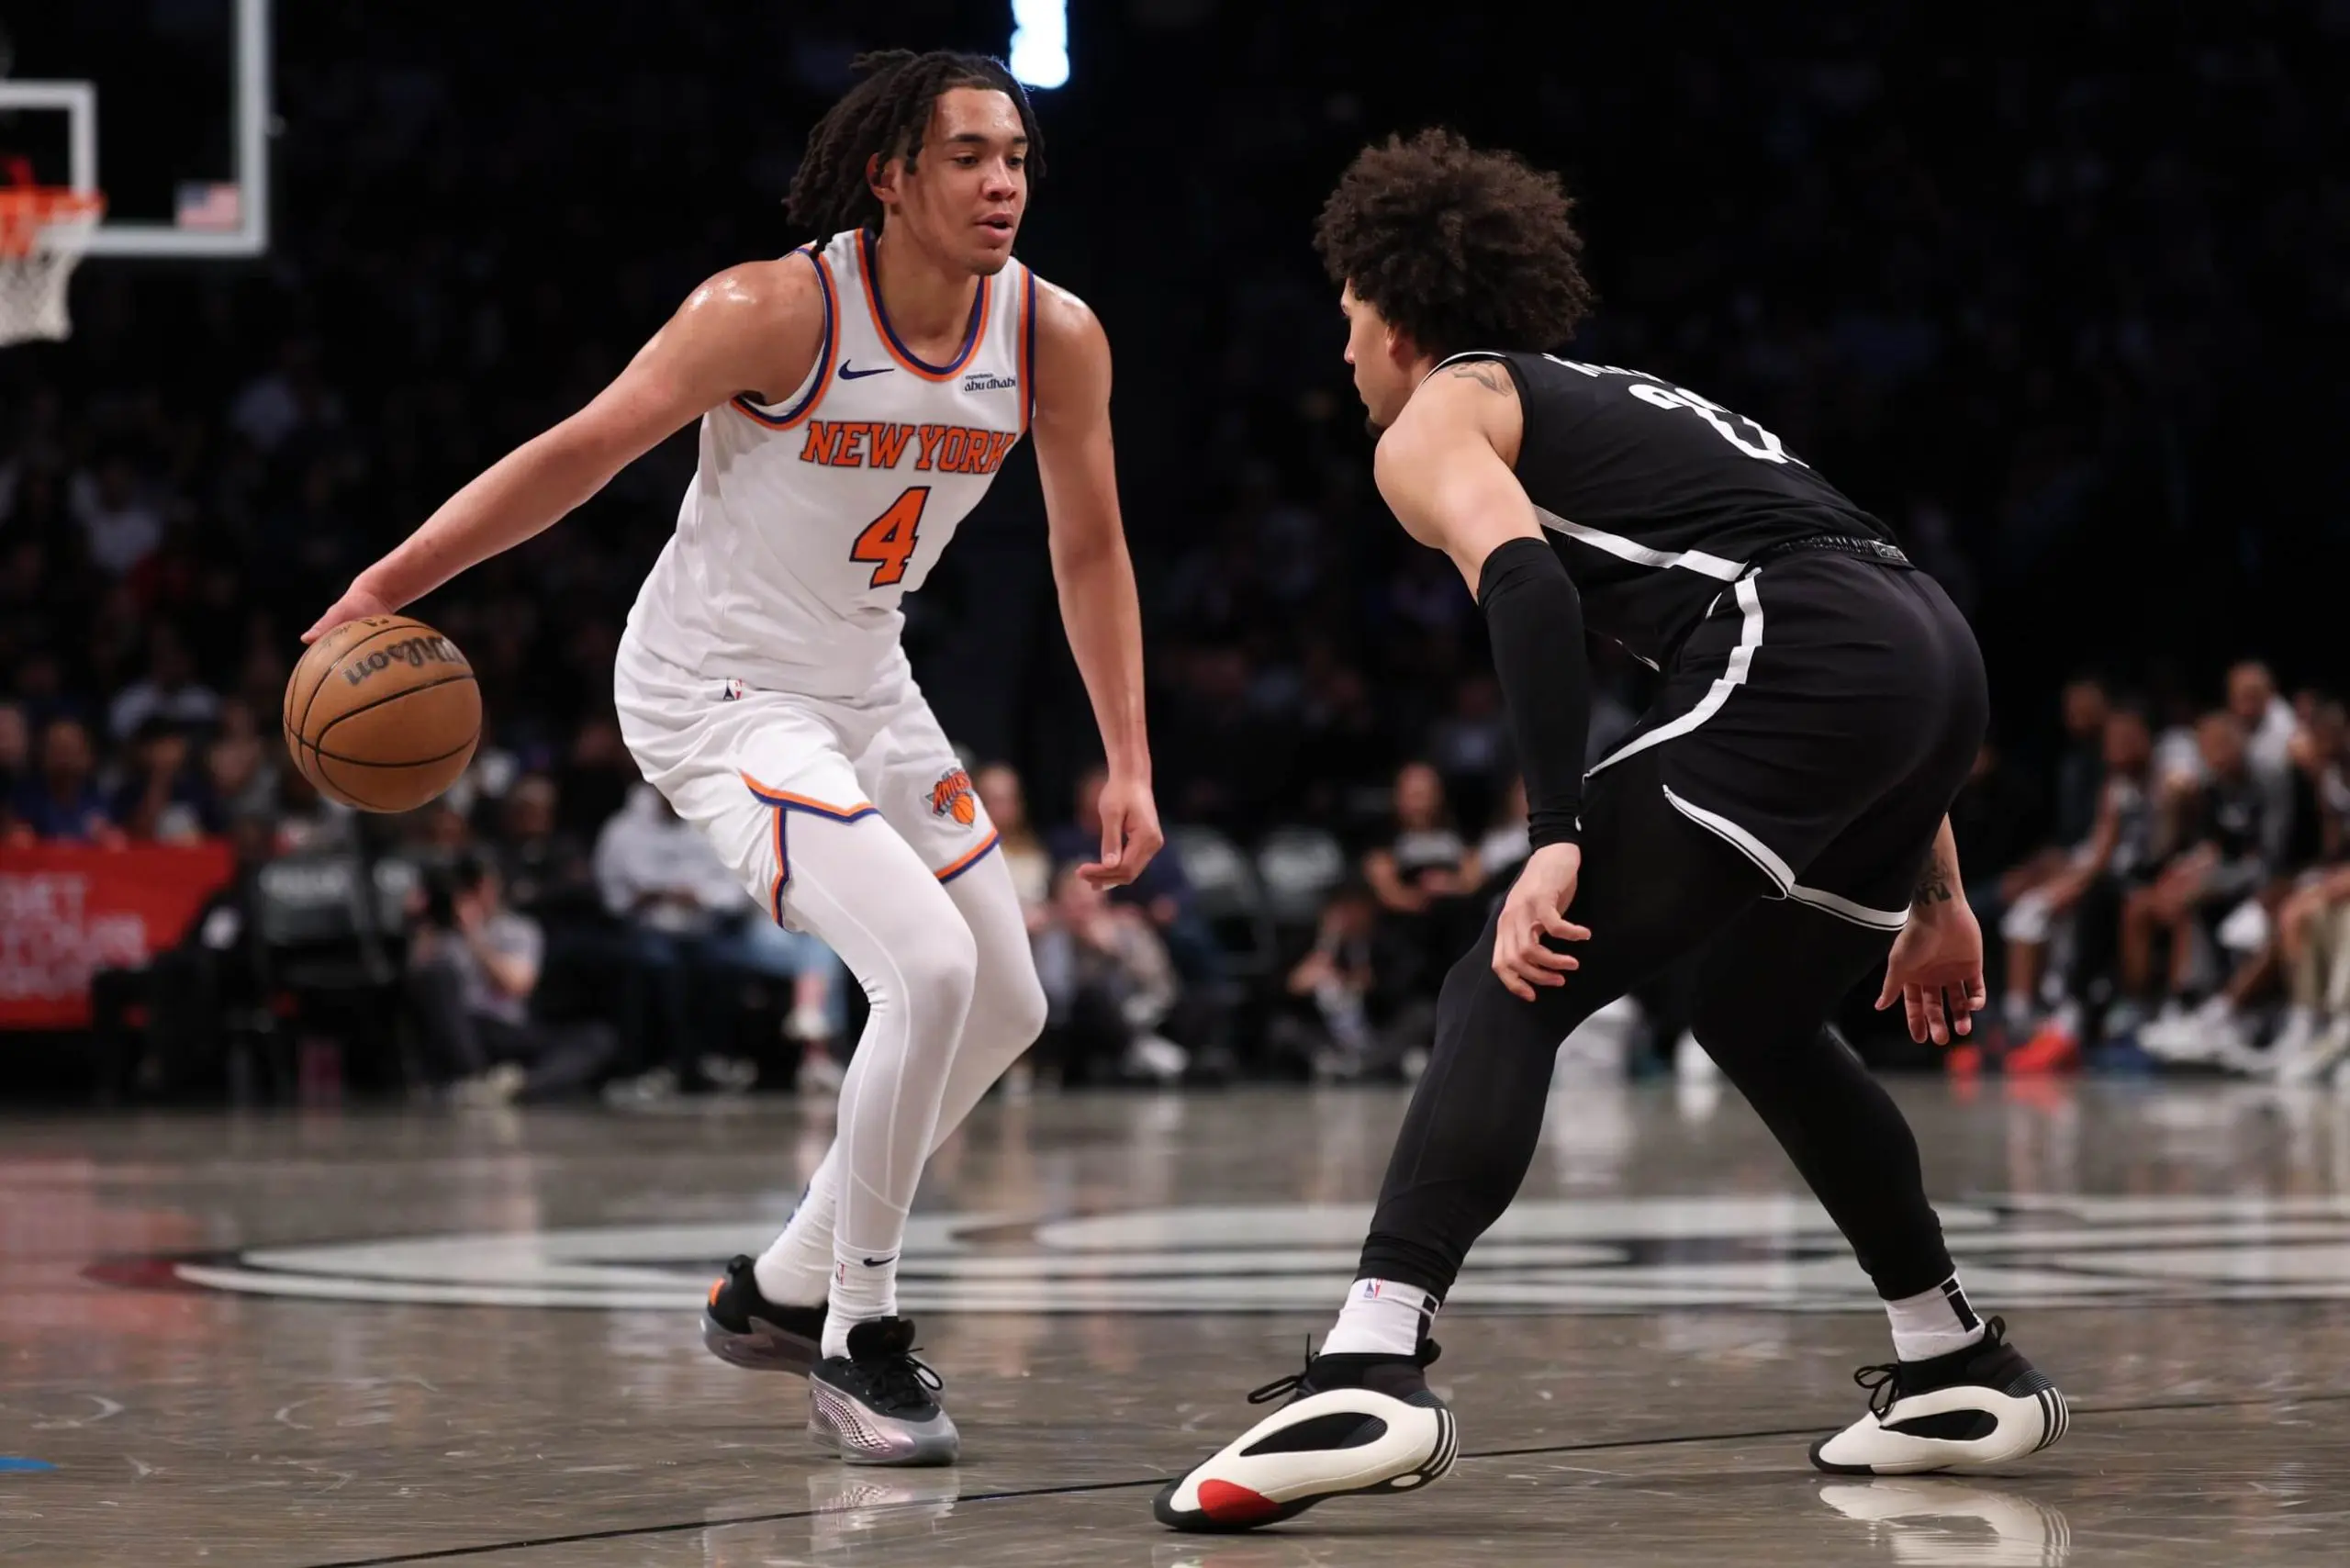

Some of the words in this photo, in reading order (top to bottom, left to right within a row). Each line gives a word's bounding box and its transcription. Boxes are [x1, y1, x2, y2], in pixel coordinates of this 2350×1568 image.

[964, 380, 985, 392] abu
[986, 376, 1016, 389] dhabi
[800, 420, 915, 469] NEW
[914, 424, 1016, 474] YORK
[849, 486, 931, 589] 4
